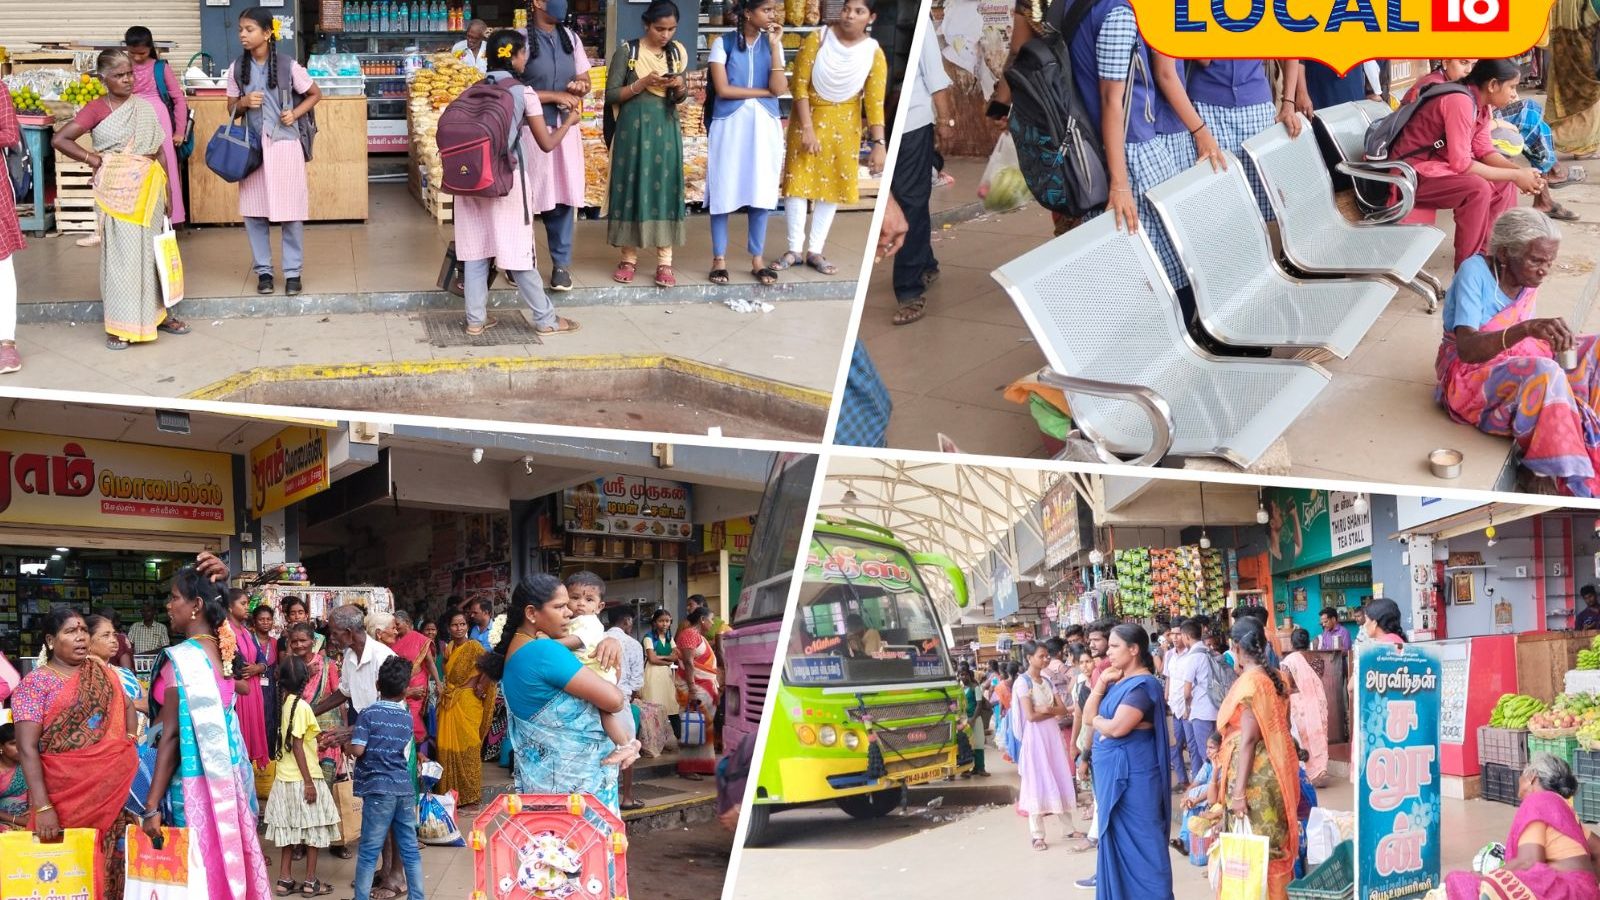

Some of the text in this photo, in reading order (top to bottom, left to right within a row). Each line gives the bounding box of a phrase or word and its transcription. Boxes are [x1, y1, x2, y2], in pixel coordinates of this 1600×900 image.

[98, 469, 223, 506] மொபைல்ஸ்
[1338, 529, 1364, 550] TEA STALL
[1366, 666, 1436, 694] அரவிந்தன்
